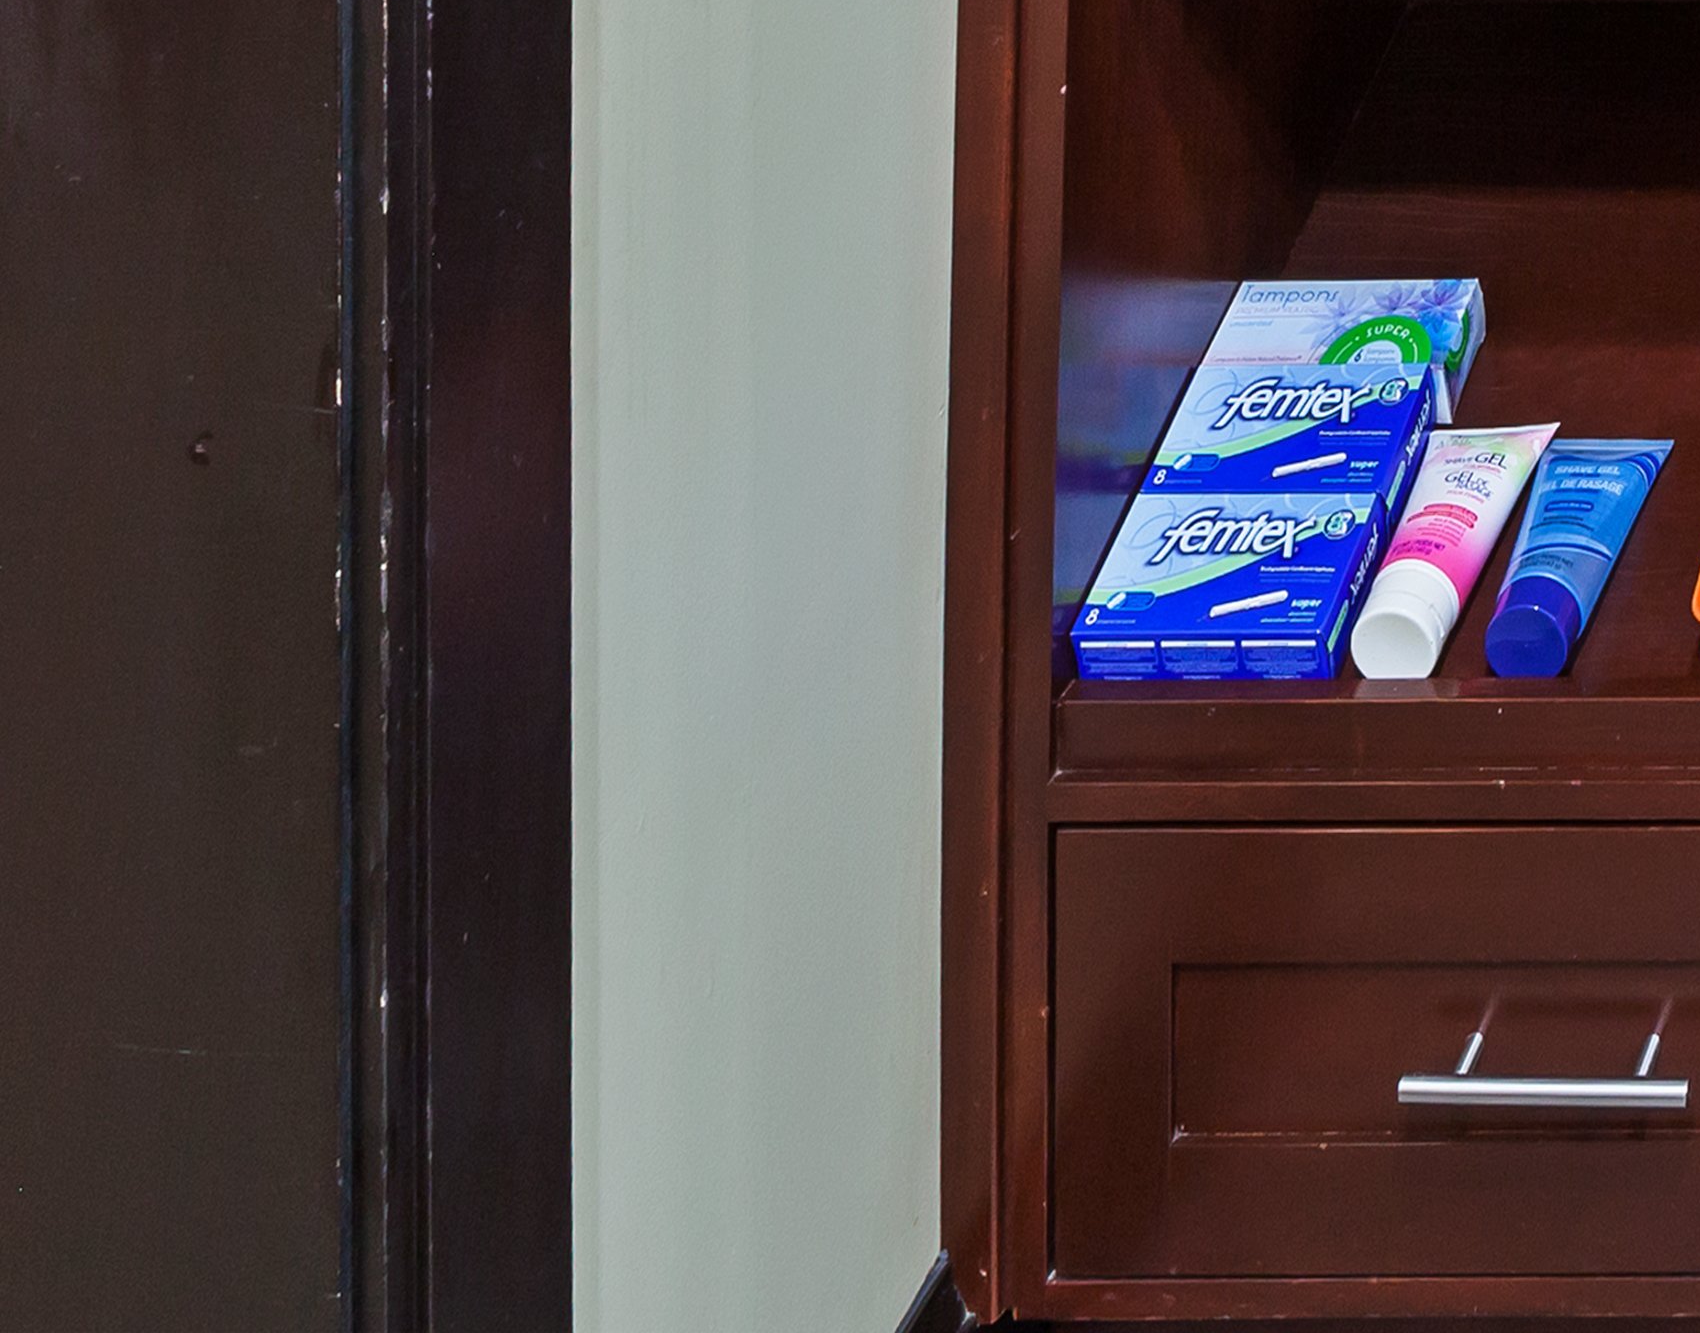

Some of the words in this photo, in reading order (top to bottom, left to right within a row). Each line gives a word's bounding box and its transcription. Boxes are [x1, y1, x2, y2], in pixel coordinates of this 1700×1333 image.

[1240, 284, 1340, 305] Tampons
[1365, 325, 1411, 340] SUPER
[1349, 459, 1380, 471] super
[1554, 464, 1595, 475] SHAVE
[1597, 465, 1620, 476] GEL
[1151, 507, 1317, 565] femtex
